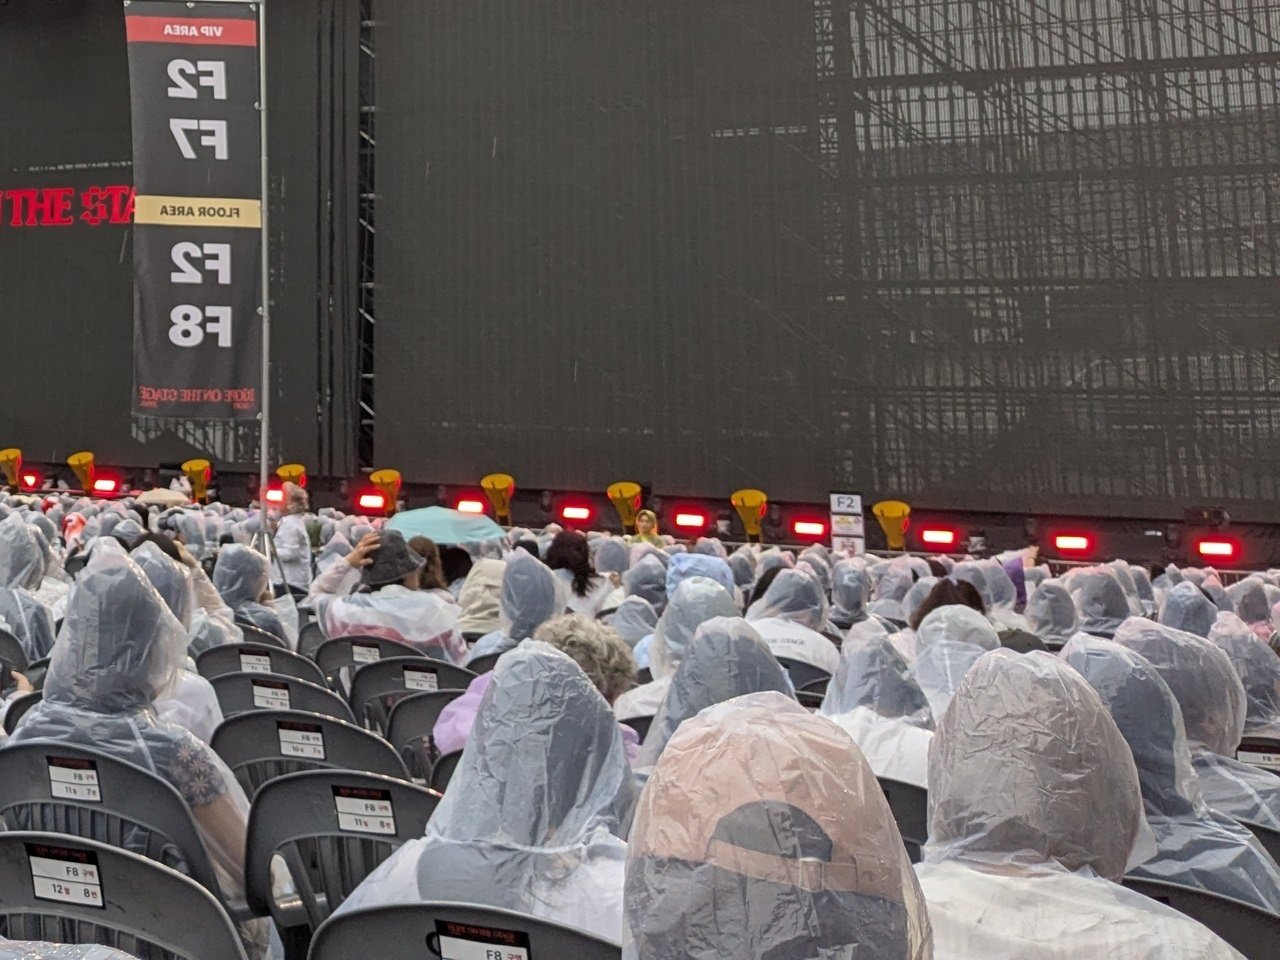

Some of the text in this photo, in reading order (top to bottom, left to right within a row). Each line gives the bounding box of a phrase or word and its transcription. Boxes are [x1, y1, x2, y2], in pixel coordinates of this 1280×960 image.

[6, 188, 75, 227] THE
[837, 496, 855, 508] F2
[66, 866, 79, 877] F8
